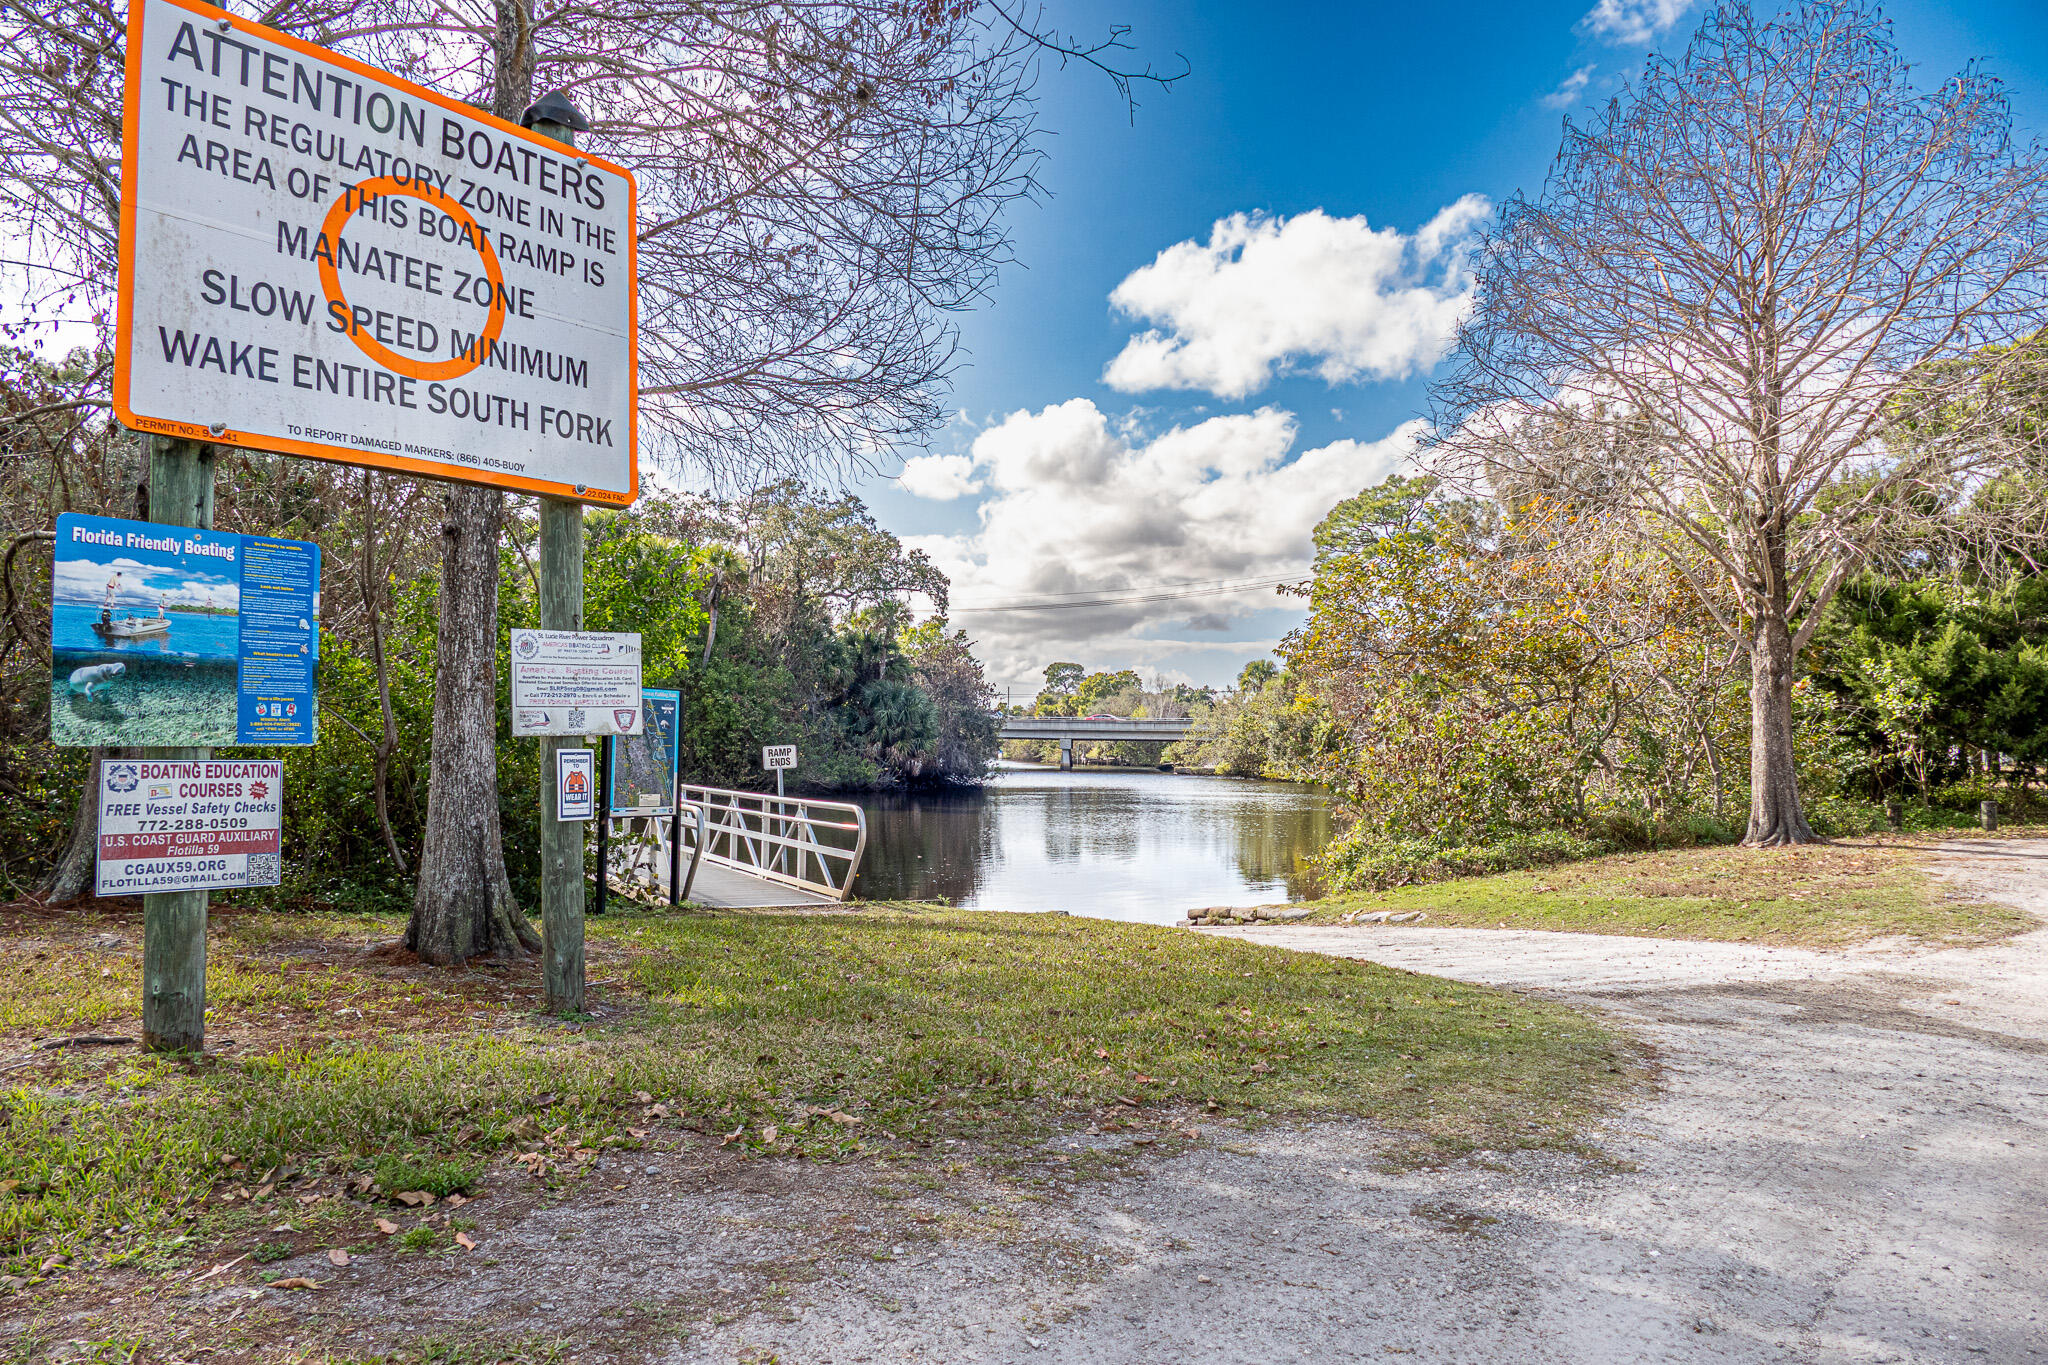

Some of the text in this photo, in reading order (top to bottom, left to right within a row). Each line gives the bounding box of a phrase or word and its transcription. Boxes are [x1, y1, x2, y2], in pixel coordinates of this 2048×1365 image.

[167, 21, 606, 210] ATTENTION BOATERS
[161, 77, 616, 255] THE REGULATORY ZONE IN THE
[177, 134, 605, 287] AREA OF THIS BOAT RAMP IS
[277, 220, 535, 319] MANATEE ZONE
[201, 269, 588, 388] SLOW SPEED MINIMUM
[158, 326, 613, 447] WAKE ENTIRE SOUTH FORK
[136, 418, 176, 432] PERMIT
[287, 424, 526, 473] TO REPORT DAMAGED MARKERS: (866) 405-BUOY
[72, 526, 236, 561] Florida Friendly Boating
[589, 634, 615, 642] Squadron
[768, 748, 792, 767] RAMP ENDS
[140, 763, 279, 779] BOATING EDUCATION
[179, 783, 243, 798] COURSES
[566, 793, 588, 801] WEAR IT
[105, 801, 276, 816] FREE Vessel Safety Checks
[138, 817, 248, 831] 772-288-0509
[105, 831, 275, 847] U.S. COAST GUARD AUXILIARY
[167, 844, 220, 856] Flotilla 59
[124, 860, 226, 876] CGAUX59.ORG
[102, 872, 246, 888] FLOTILLA59@GMAIL.COM
